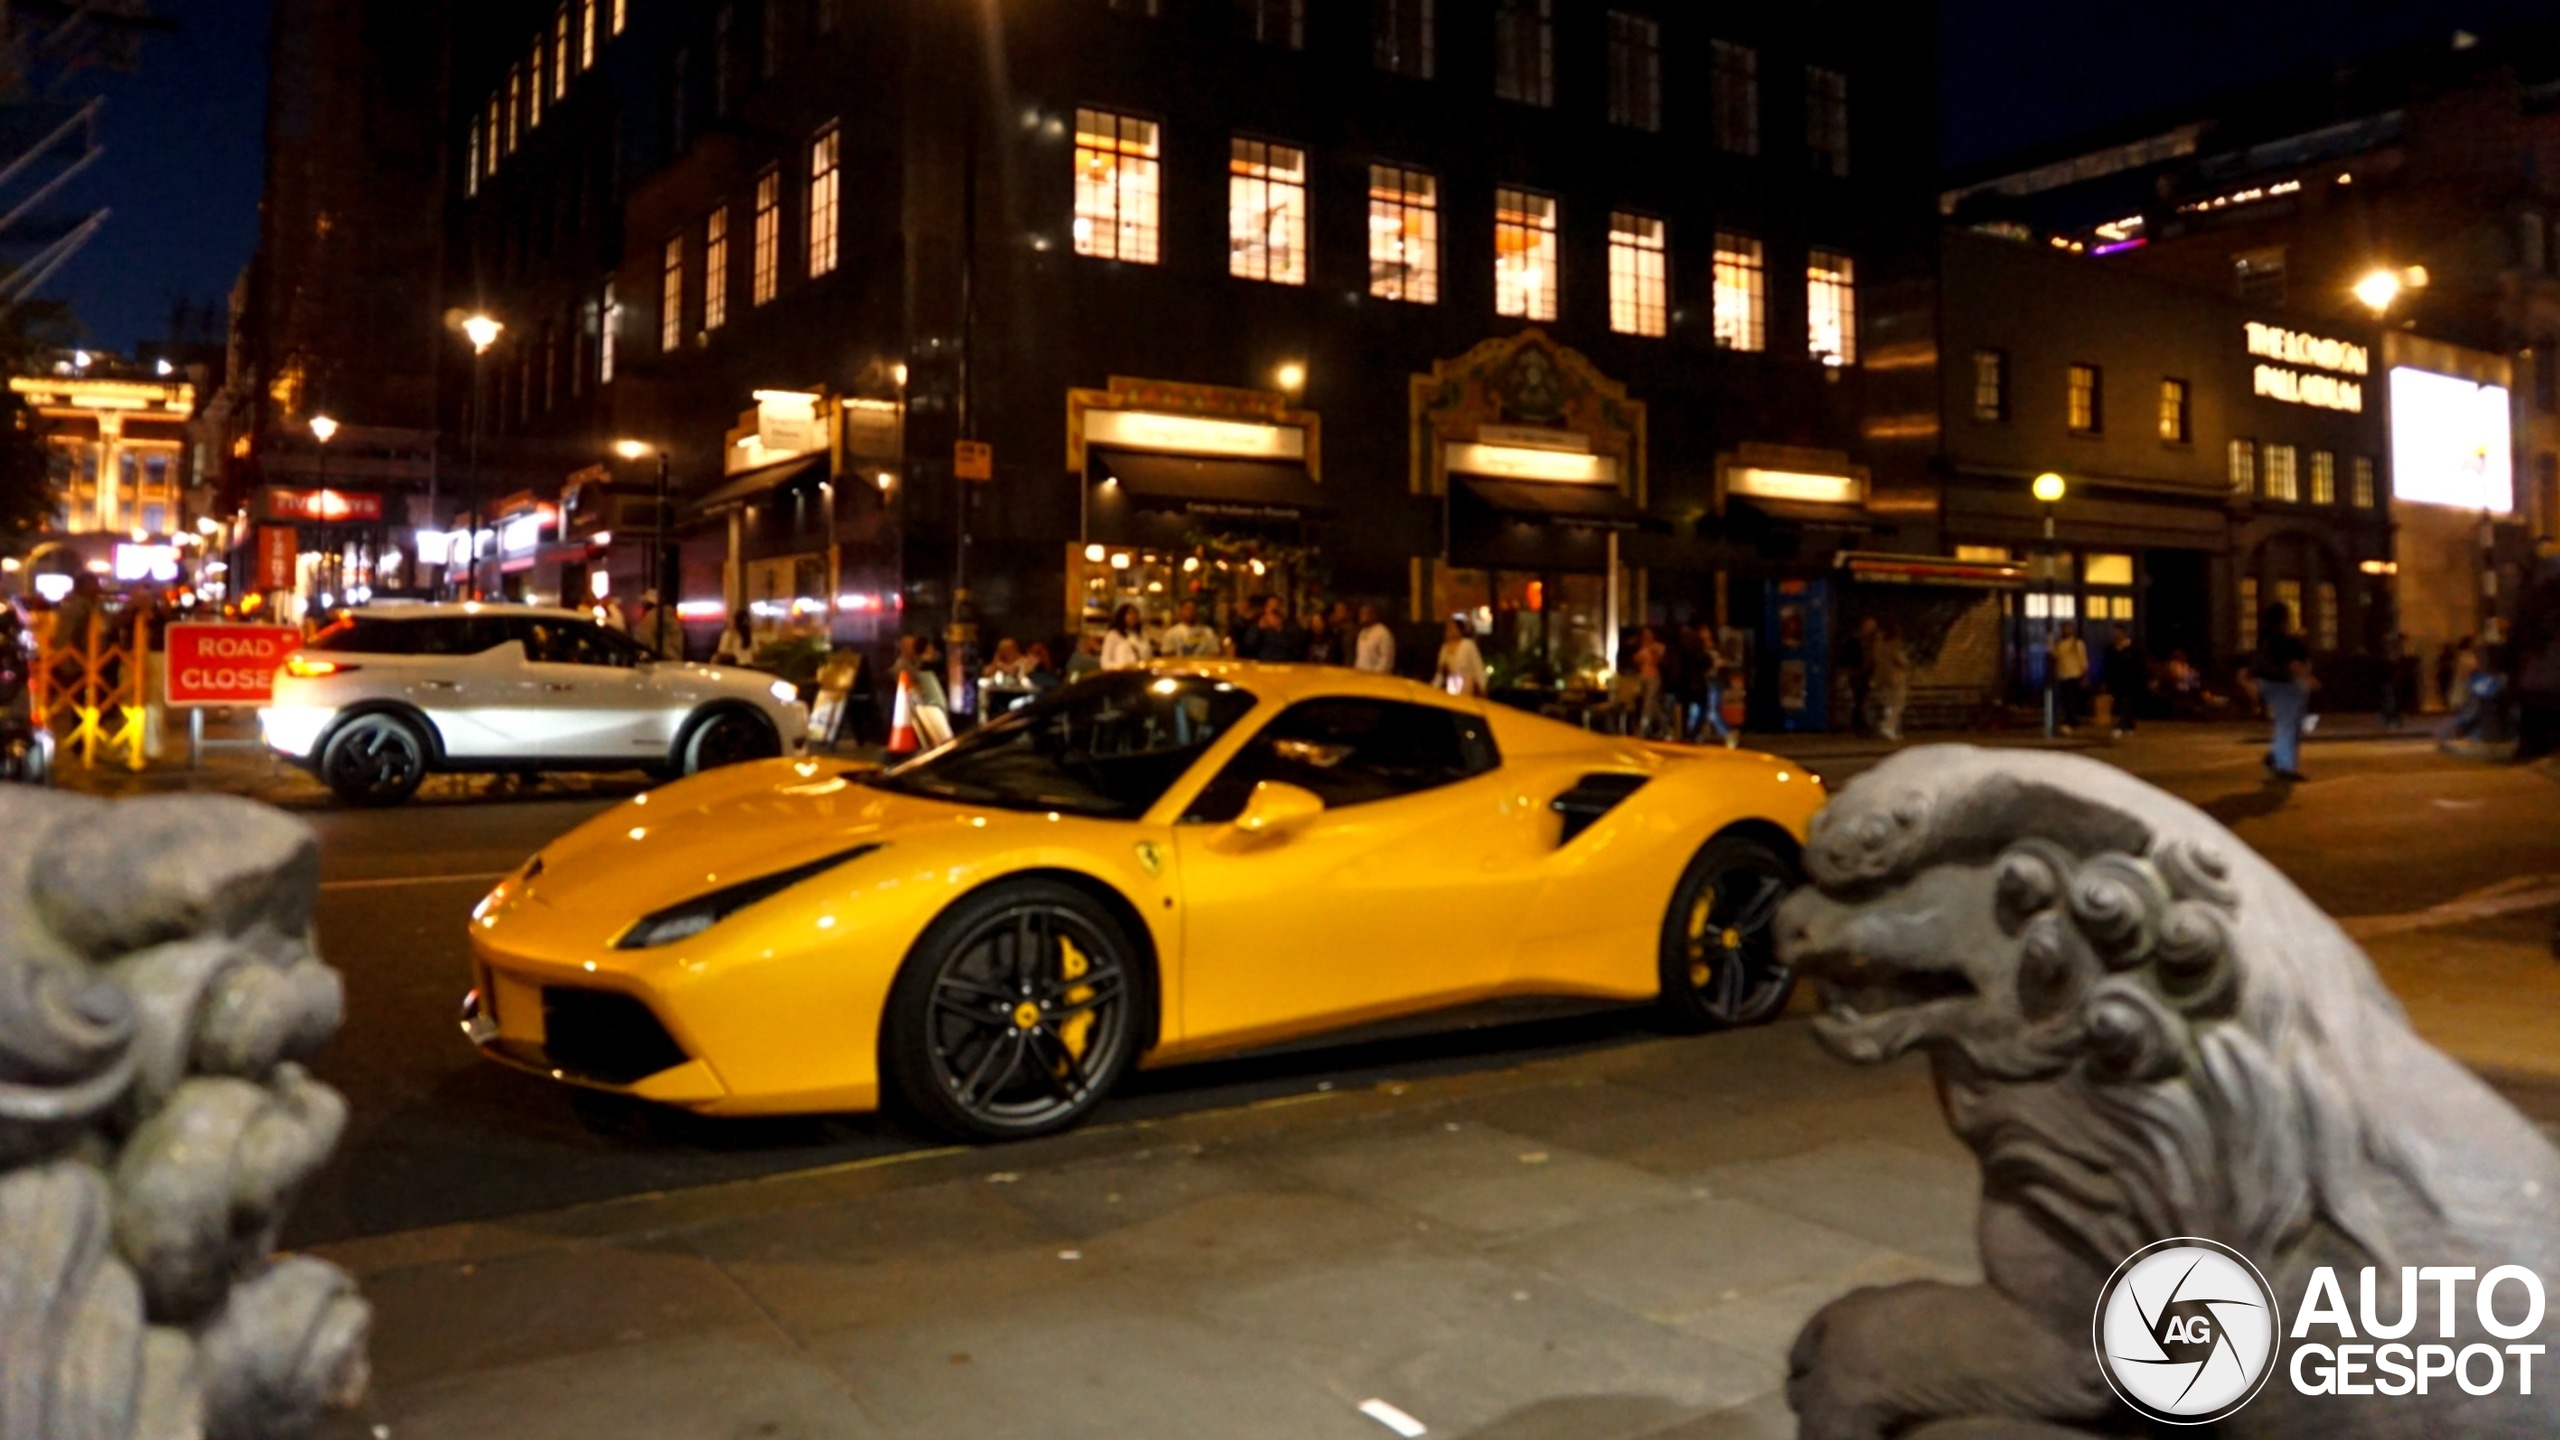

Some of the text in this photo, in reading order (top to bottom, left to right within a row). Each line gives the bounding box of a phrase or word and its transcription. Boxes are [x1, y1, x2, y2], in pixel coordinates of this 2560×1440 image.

[2284, 331, 2368, 376] LONDON
[197, 637, 275, 658] ROAD
[180, 667, 271, 691] CLOSE
